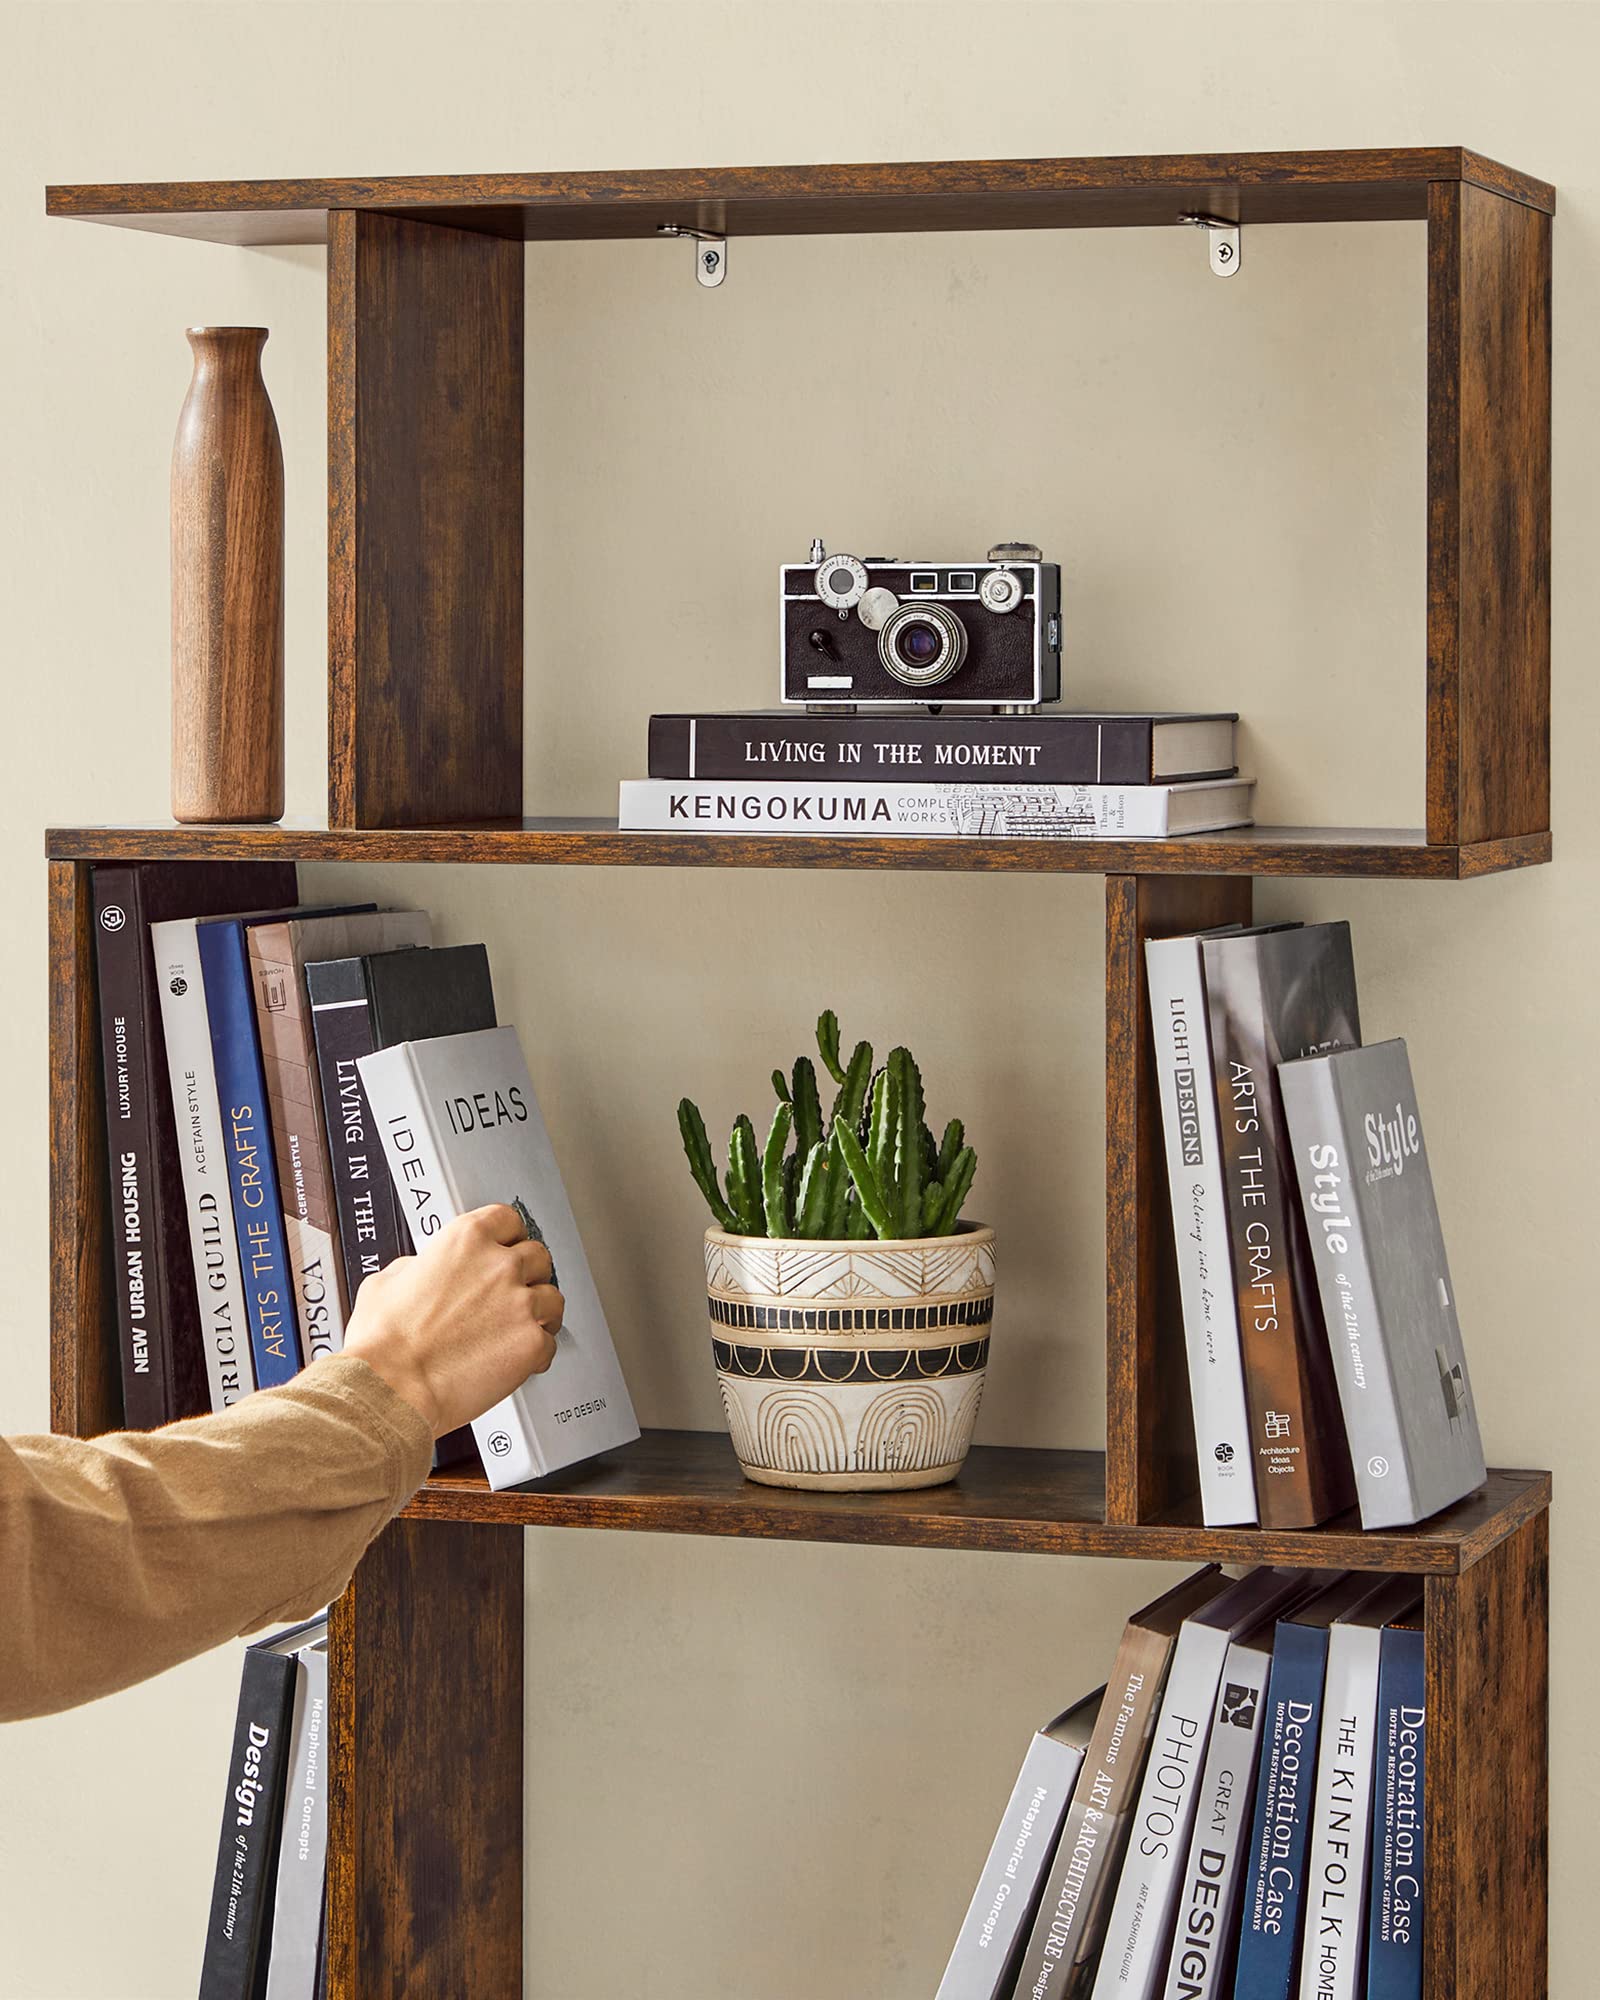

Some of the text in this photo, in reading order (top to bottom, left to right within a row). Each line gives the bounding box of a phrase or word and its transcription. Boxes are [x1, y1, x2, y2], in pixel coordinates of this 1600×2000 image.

[744, 740, 1041, 766] LIVING IN THE MOMENT
[669, 794, 971, 821] KENGOKUMA COMPLETE
[898, 812, 947, 822] WORKS
[1116, 794, 1124, 829] Hudson
[115, 1017, 131, 1119] LUXURY HOUSE
[1170, 998, 1201, 1164] LIGHT DESIGNS
[185, 1071, 207, 1174] ACETAIN STYLE
[336, 1059, 364, 1144] LIVING
[445, 1087, 528, 1135] IDEAS
[289, 1135, 301, 1168] STYLE
[1365, 1103, 1419, 1176] Style
[348, 1155, 369, 1180] IN
[388, 1115, 442, 1237] IDEAS
[291, 1170, 308, 1215] CERTAIN
[1229, 1061, 1278, 1331] ARTS THE CRAFTS
[1308, 1144, 1352, 1254] Style
[231, 1105, 286, 1358] ARTS THE CRAFTS
[353, 1191, 377, 1243] THE
[121, 1152, 149, 1374] NEW URBAN HOUSING
[199, 1193, 229, 1290] GUILD
[1336, 1273, 1352, 1289] of
[1340, 1290, 1354, 1311] the
[1350, 1342, 1367, 1389] century
[554, 1398, 607, 1424] TOP DESIGN
[1259, 1446, 1300, 1456] Architecture
[1268, 1465, 1295, 1475] Objects
[1271, 1456, 1291, 1464] Ideas
[1124, 1673, 1144, 1702] The
[1106, 1704, 1135, 1764] Famous
[1337, 1716, 1357, 1757] THE
[235, 1722, 270, 1827] Design
[298, 1698, 323, 1861] Metaphorical Concepts
[1089, 1769, 1114, 1809] ART
[1140, 1714, 1198, 1860] PHOTOS
[1085, 1806, 1104, 1822] &
[1210, 1769, 1234, 1837] GREAT
[1252, 1702, 1285, 1931] HOTELS RESTAURANTS GARDENS GETAWAYS
[1263, 1699, 1313, 1935] Decoration Case
[1381, 1708, 1398, 1942] HOTELS RESTAURANTS GARDENS GETAWAYS
[1392, 1705, 1426, 1944] Decoration Case
[234, 1850, 246, 1869] the
[235, 1834, 248, 1851] of
[1319, 1768, 1355, 1937] KINFOLK
[979, 1785, 1048, 1949] Metaphorical Concepts
[1044, 1821, 1099, 1959] ARCHITECTURE
[1138, 1882, 1149, 1903] ART
[223, 1896, 238, 1940] century
[1126, 1911, 1143, 1953] FASHION
[1119, 1951, 1133, 1983] GUIDE
